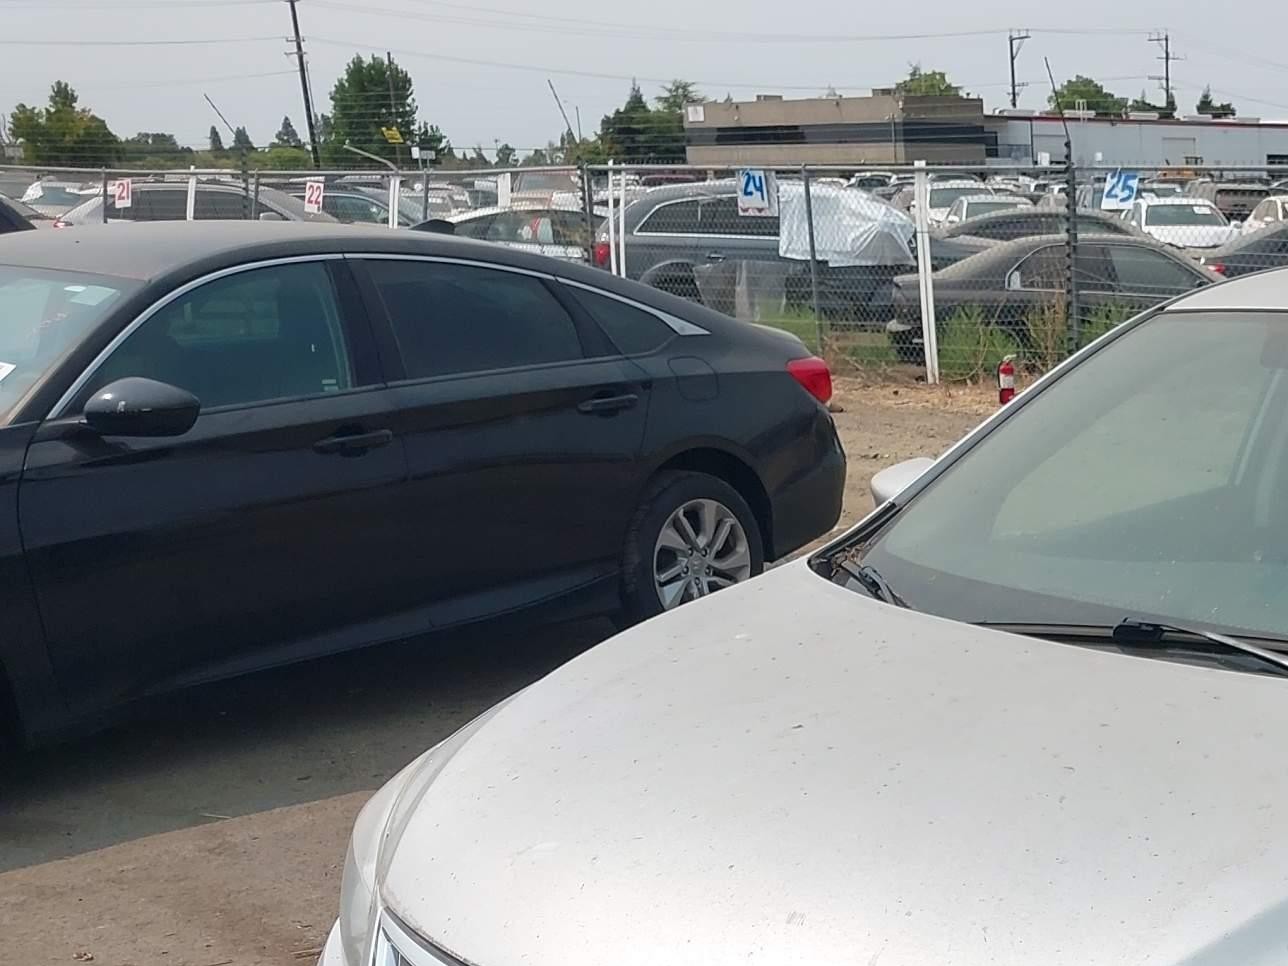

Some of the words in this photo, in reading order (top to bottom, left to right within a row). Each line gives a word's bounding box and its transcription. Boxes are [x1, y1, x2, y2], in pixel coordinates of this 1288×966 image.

[117, 181, 130, 201] 21
[307, 184, 321, 206] 22
[743, 171, 765, 202] 24
[1105, 170, 1138, 203] 25
